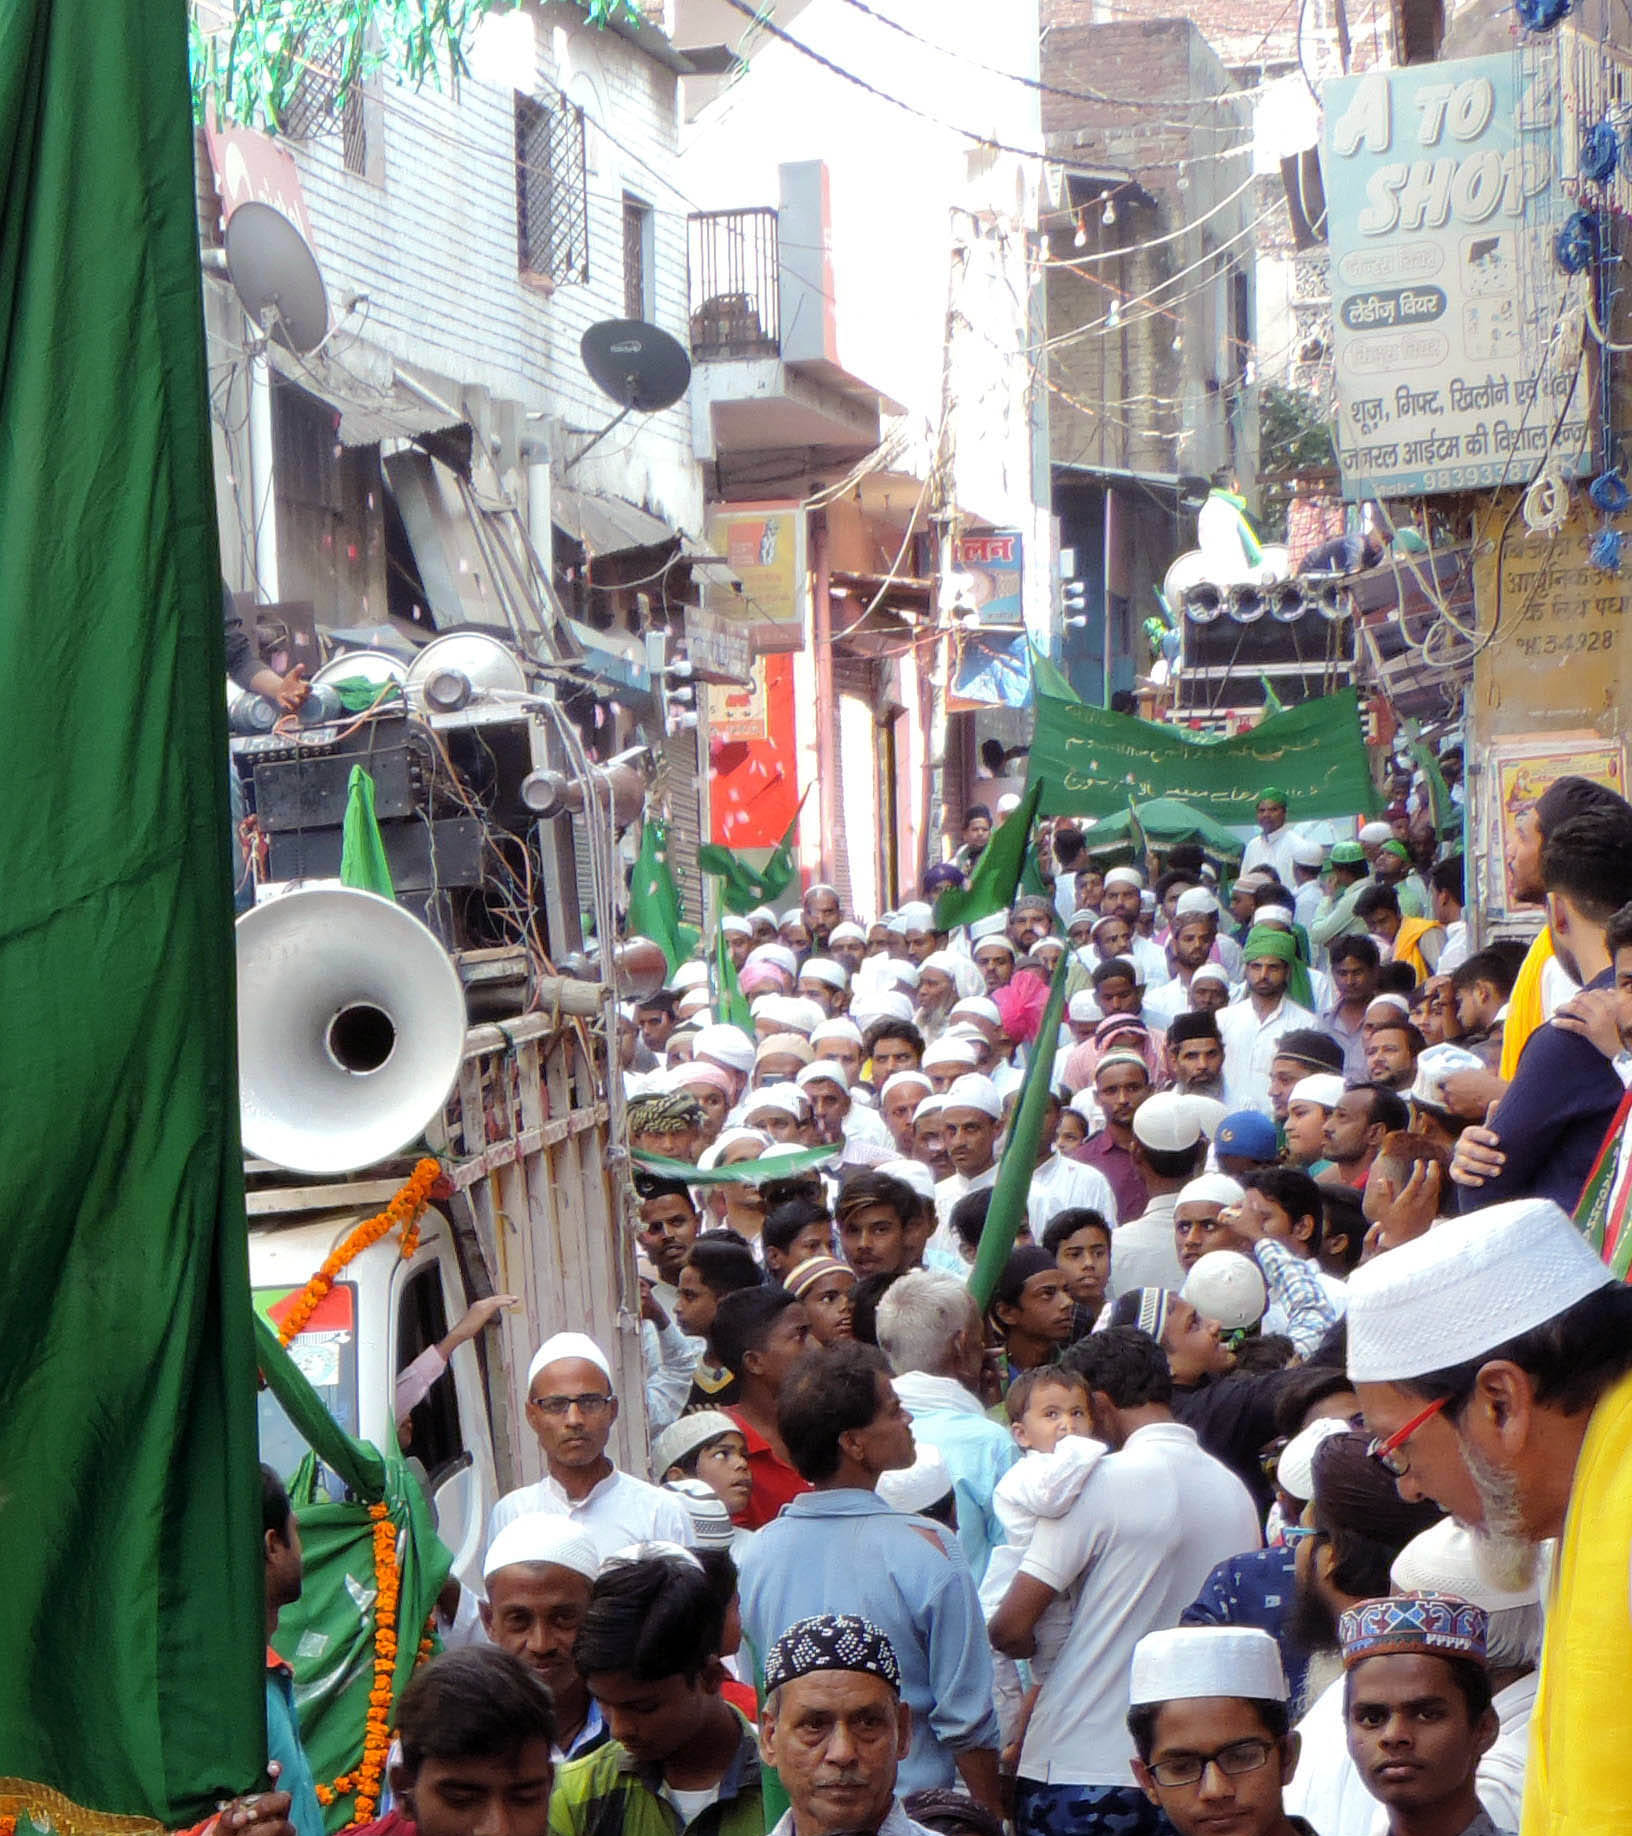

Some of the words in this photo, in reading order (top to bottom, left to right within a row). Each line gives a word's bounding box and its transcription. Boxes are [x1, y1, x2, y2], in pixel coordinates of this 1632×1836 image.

[1333, 75, 1391, 157] A
[1414, 78, 1494, 147] TO
[1358, 143, 1552, 237] SHOP
[1450, 373, 1510, 412] खिलौने
[1464, 422, 1489, 457] की
